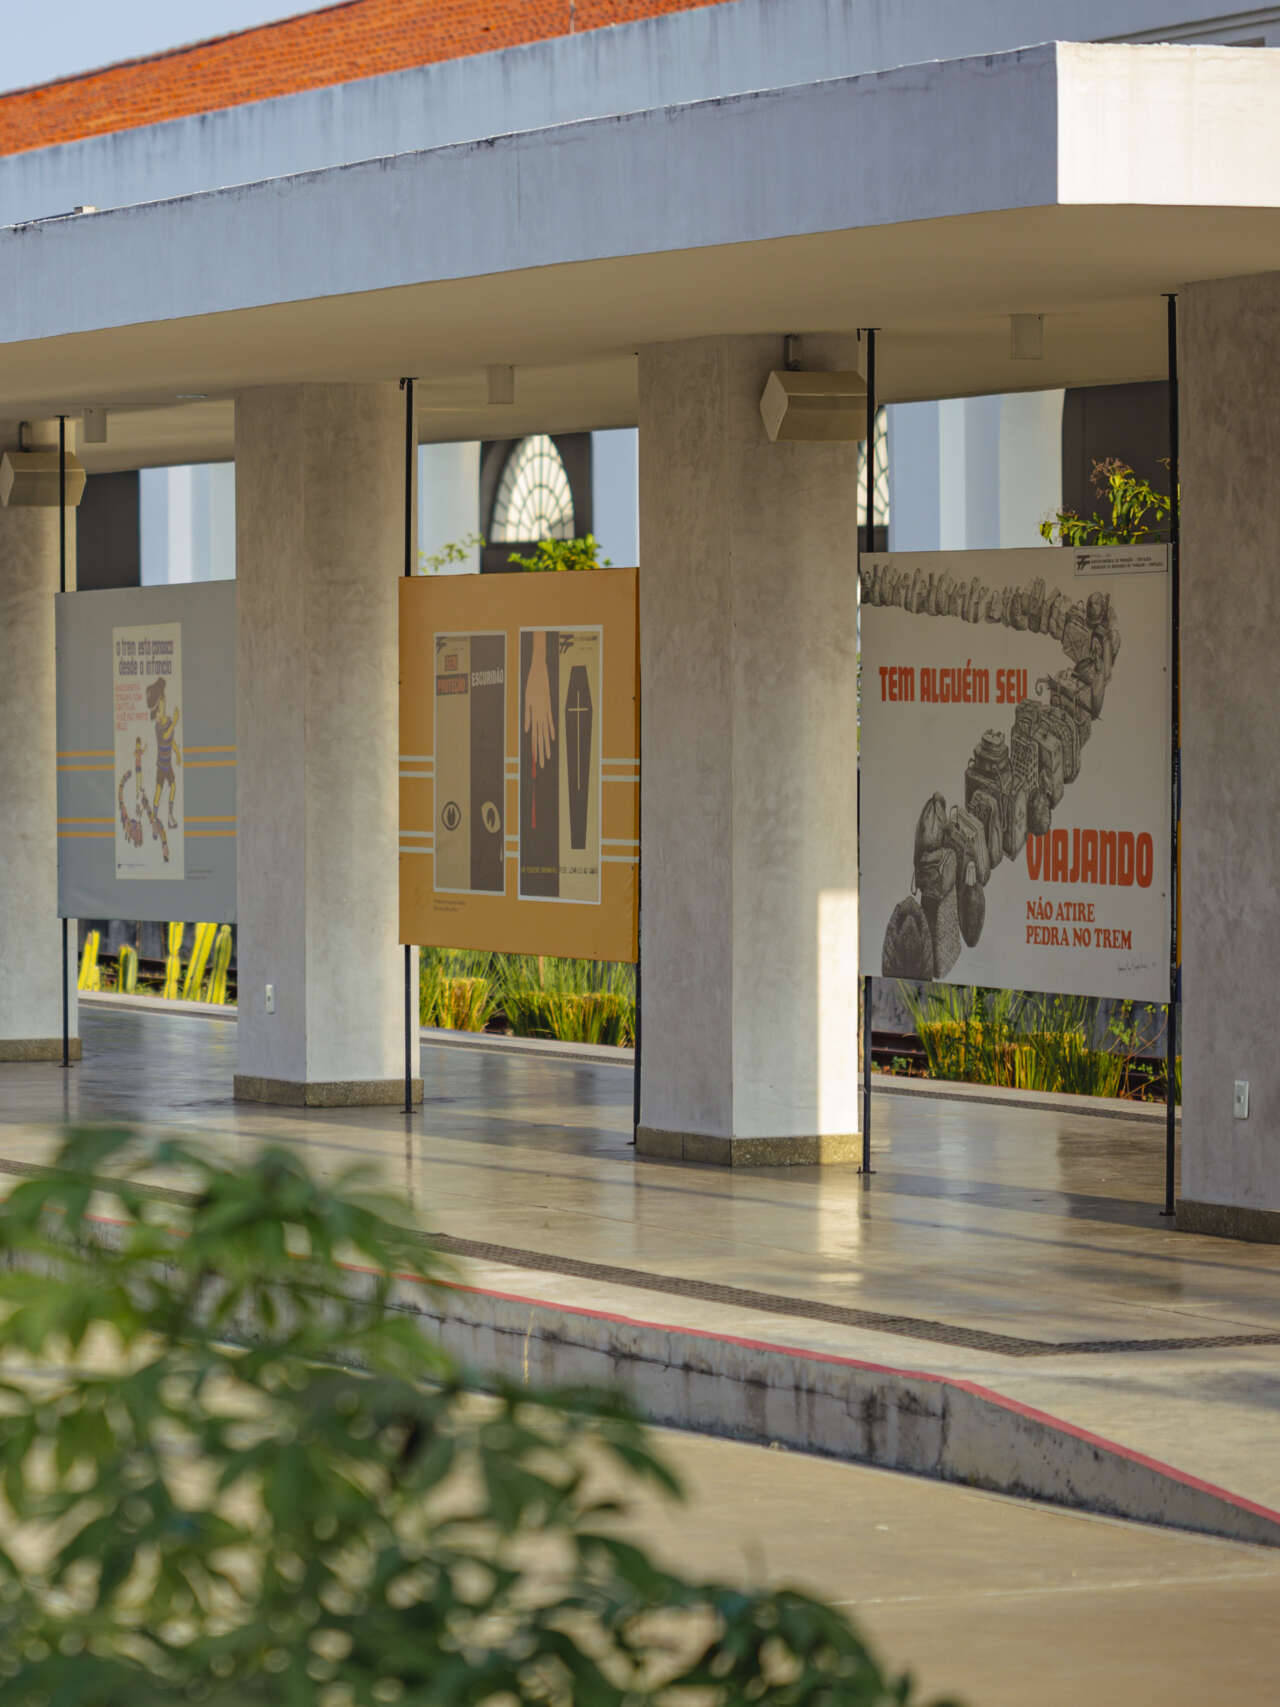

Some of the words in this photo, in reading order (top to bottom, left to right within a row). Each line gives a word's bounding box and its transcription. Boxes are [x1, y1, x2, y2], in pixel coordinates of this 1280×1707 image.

[878, 666, 915, 702] TEM
[919, 658, 990, 704] ALGUÉM
[995, 668, 1028, 704] SEU
[1025, 828, 1154, 889] VIAJANDO
[1055, 901, 1096, 923] ATIRE
[1025, 925, 1070, 947] PEDRA
[1072, 927, 1092, 948] NO
[1094, 928, 1132, 950] TREM
